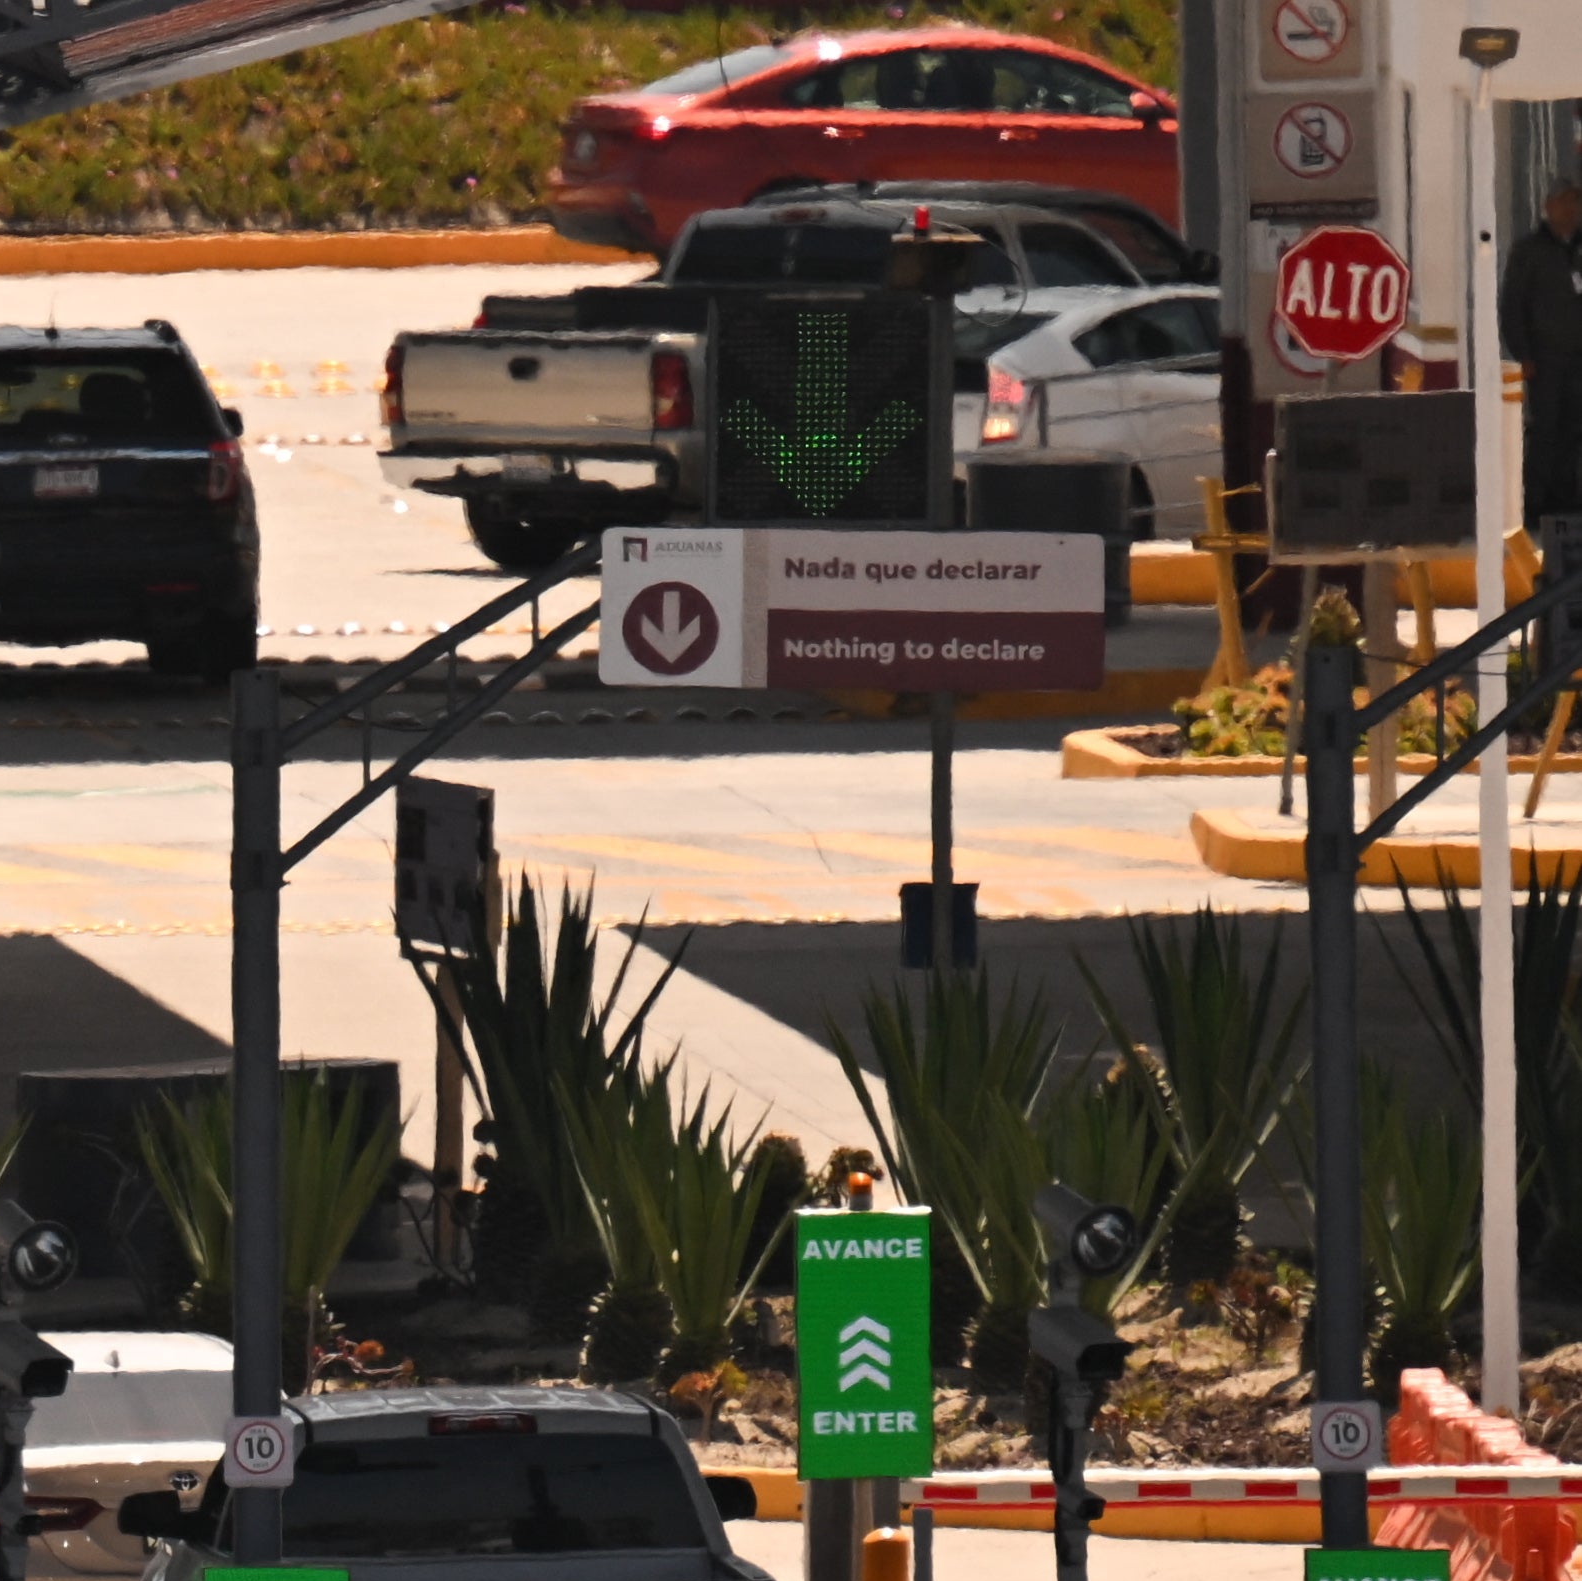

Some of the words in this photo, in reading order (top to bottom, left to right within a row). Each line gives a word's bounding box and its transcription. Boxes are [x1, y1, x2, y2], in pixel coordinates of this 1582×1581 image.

[1284, 257, 1401, 324] ALTO
[785, 557, 857, 581] Nada
[865, 563, 918, 586] que
[926, 559, 1043, 582] declarar
[784, 637, 897, 667] Nothing
[904, 640, 935, 661] to
[942, 638, 1047, 662] declare
[803, 1238, 924, 1261] AVANCE
[814, 1411, 918, 1436] ENTER
[1331, 1420, 1361, 1445] 10
[245, 1436, 275, 1461] 10
